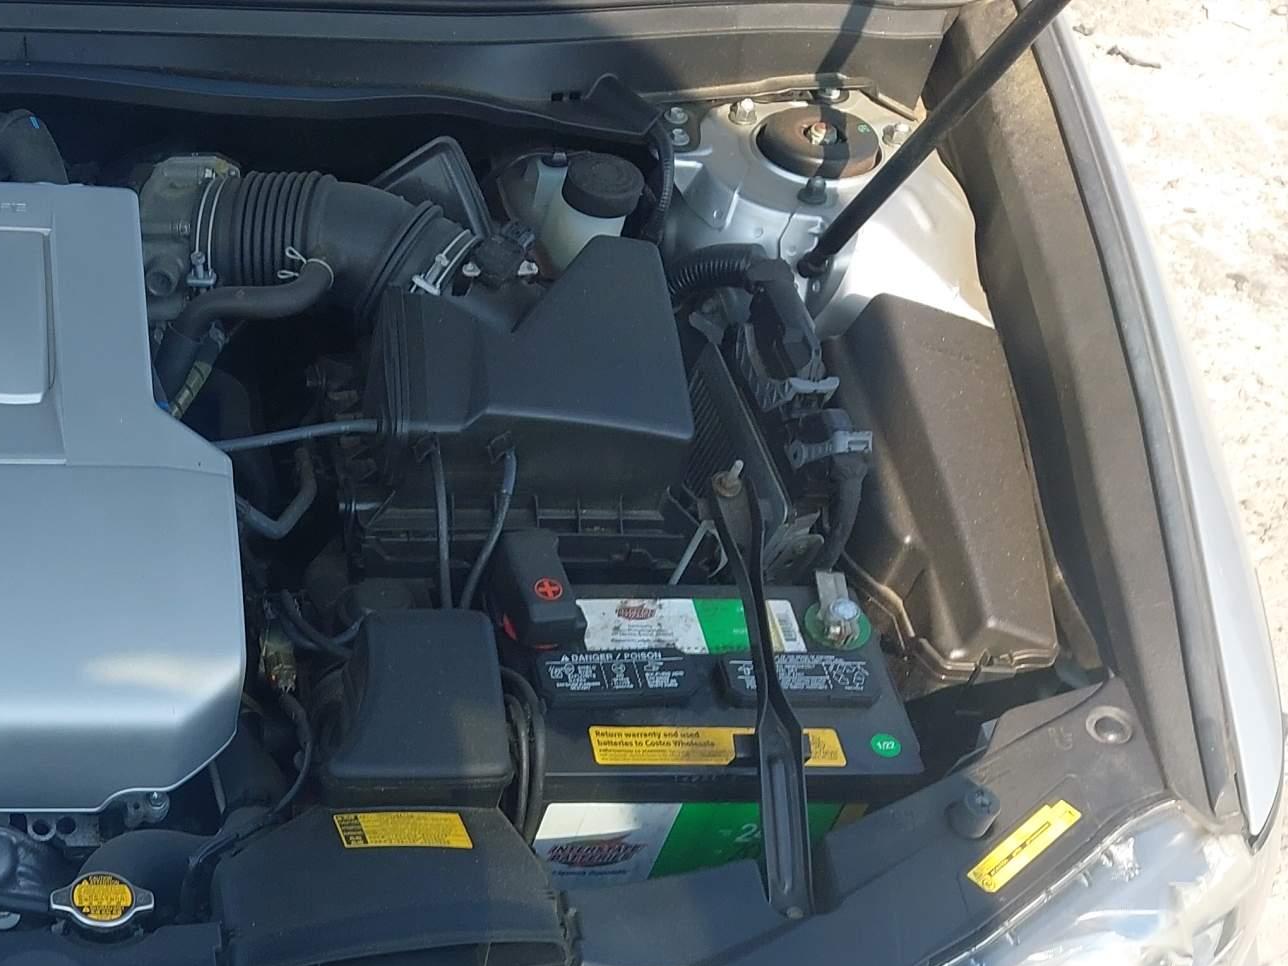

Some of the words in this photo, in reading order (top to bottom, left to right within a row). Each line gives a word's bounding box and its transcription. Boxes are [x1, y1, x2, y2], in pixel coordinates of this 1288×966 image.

[571, 654, 613, 663] DANGER
[624, 651, 662, 661] POISON
[594, 729, 622, 738] Return
[624, 730, 660, 740] warranty
[663, 730, 679, 738] and
[681, 730, 700, 738] used
[596, 738, 633, 746] batteries
